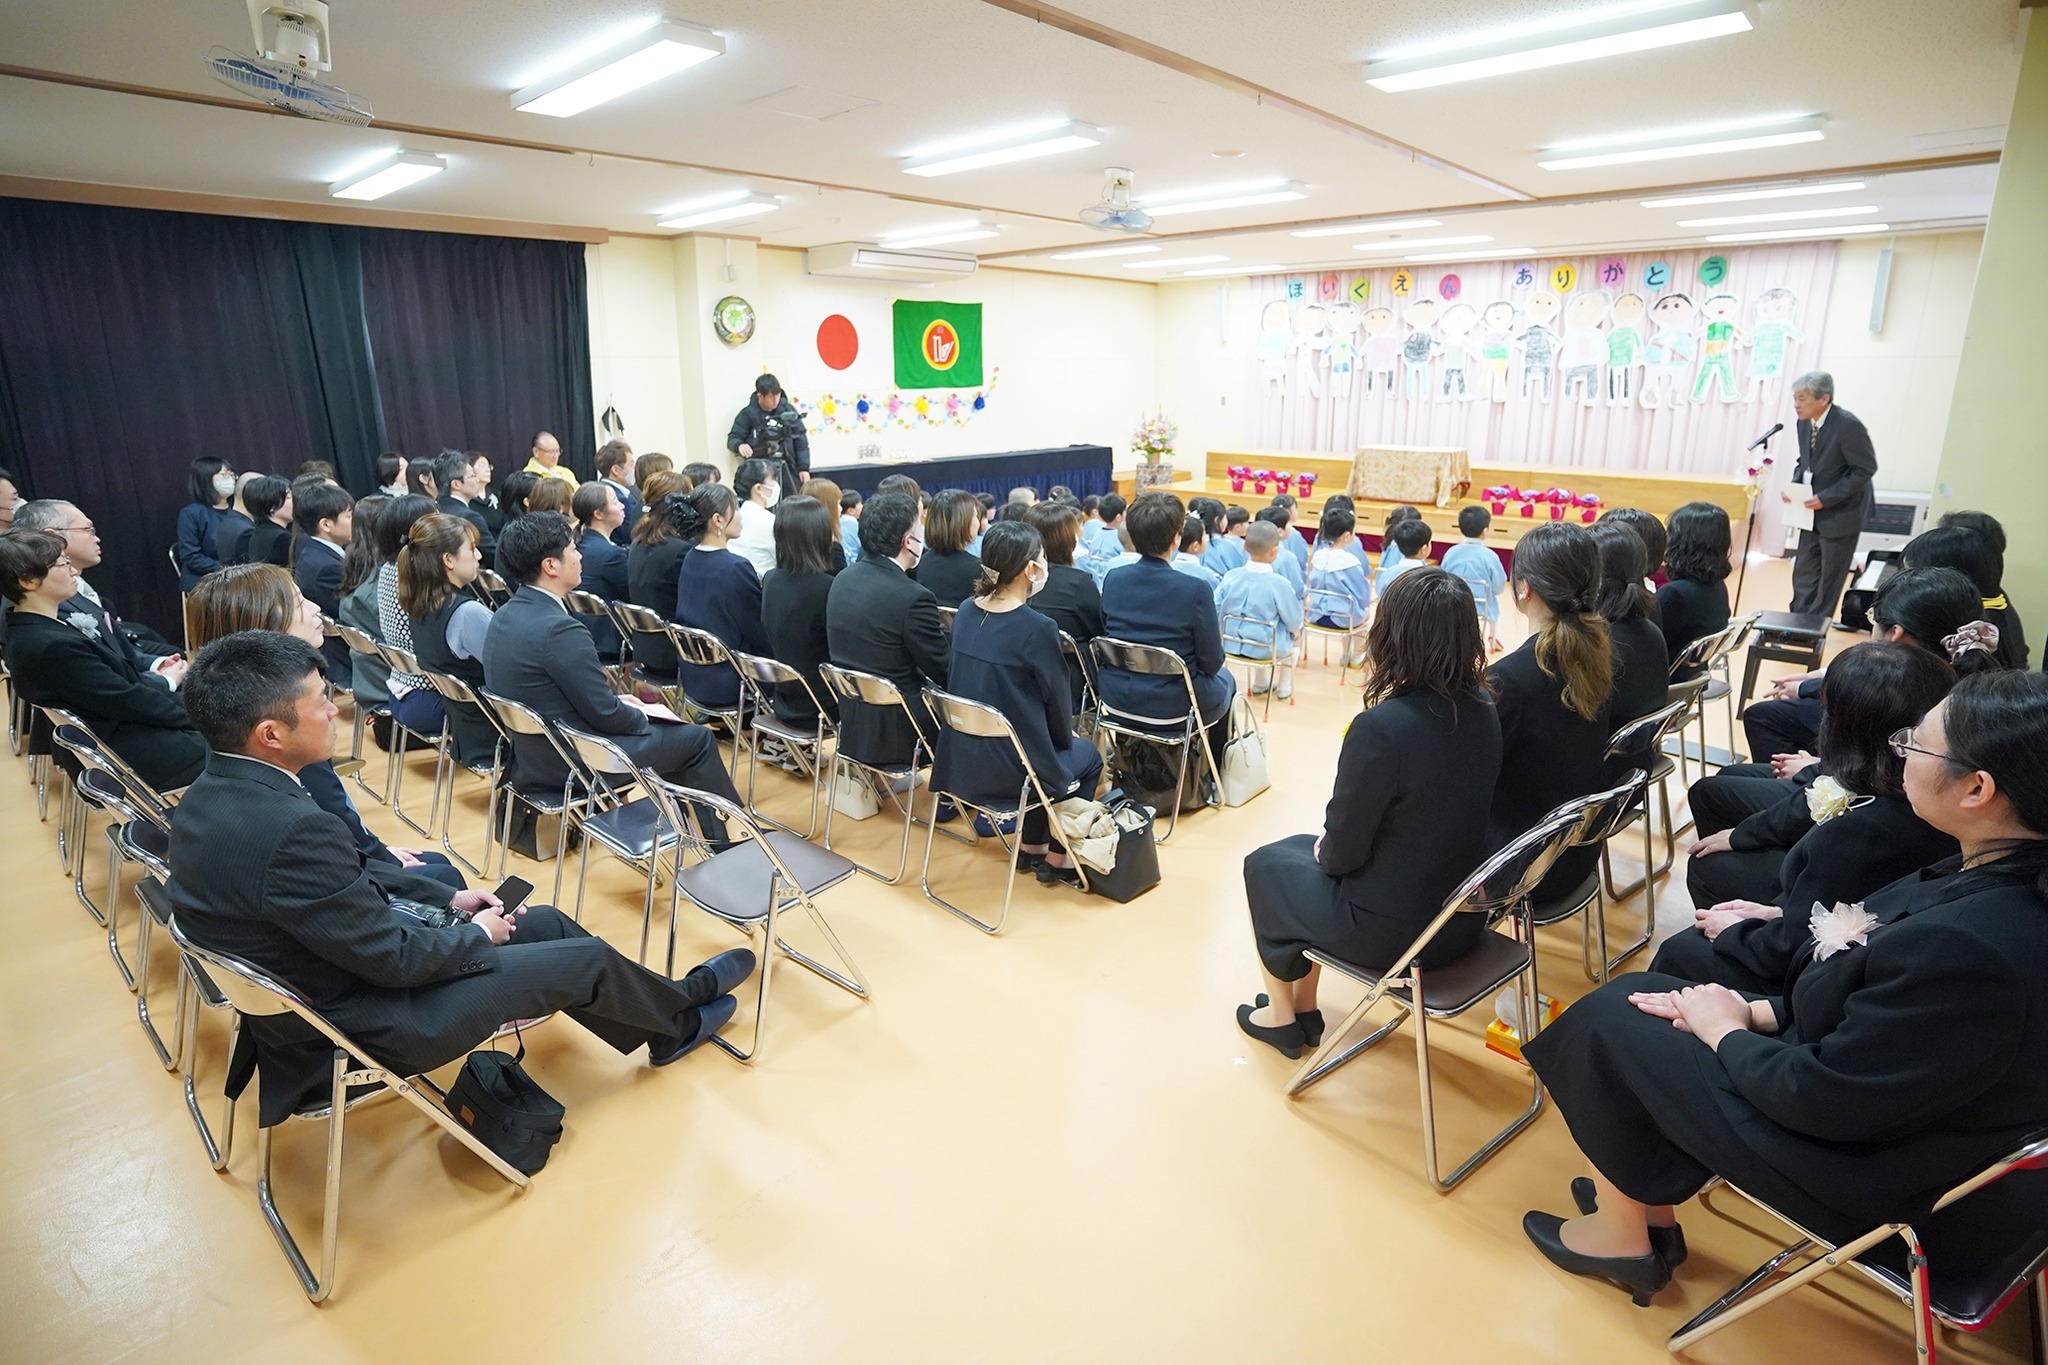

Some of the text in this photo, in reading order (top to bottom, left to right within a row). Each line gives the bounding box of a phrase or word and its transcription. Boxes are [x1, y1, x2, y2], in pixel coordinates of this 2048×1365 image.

[1288, 261, 1723, 298] ほいくえん ありがとう
